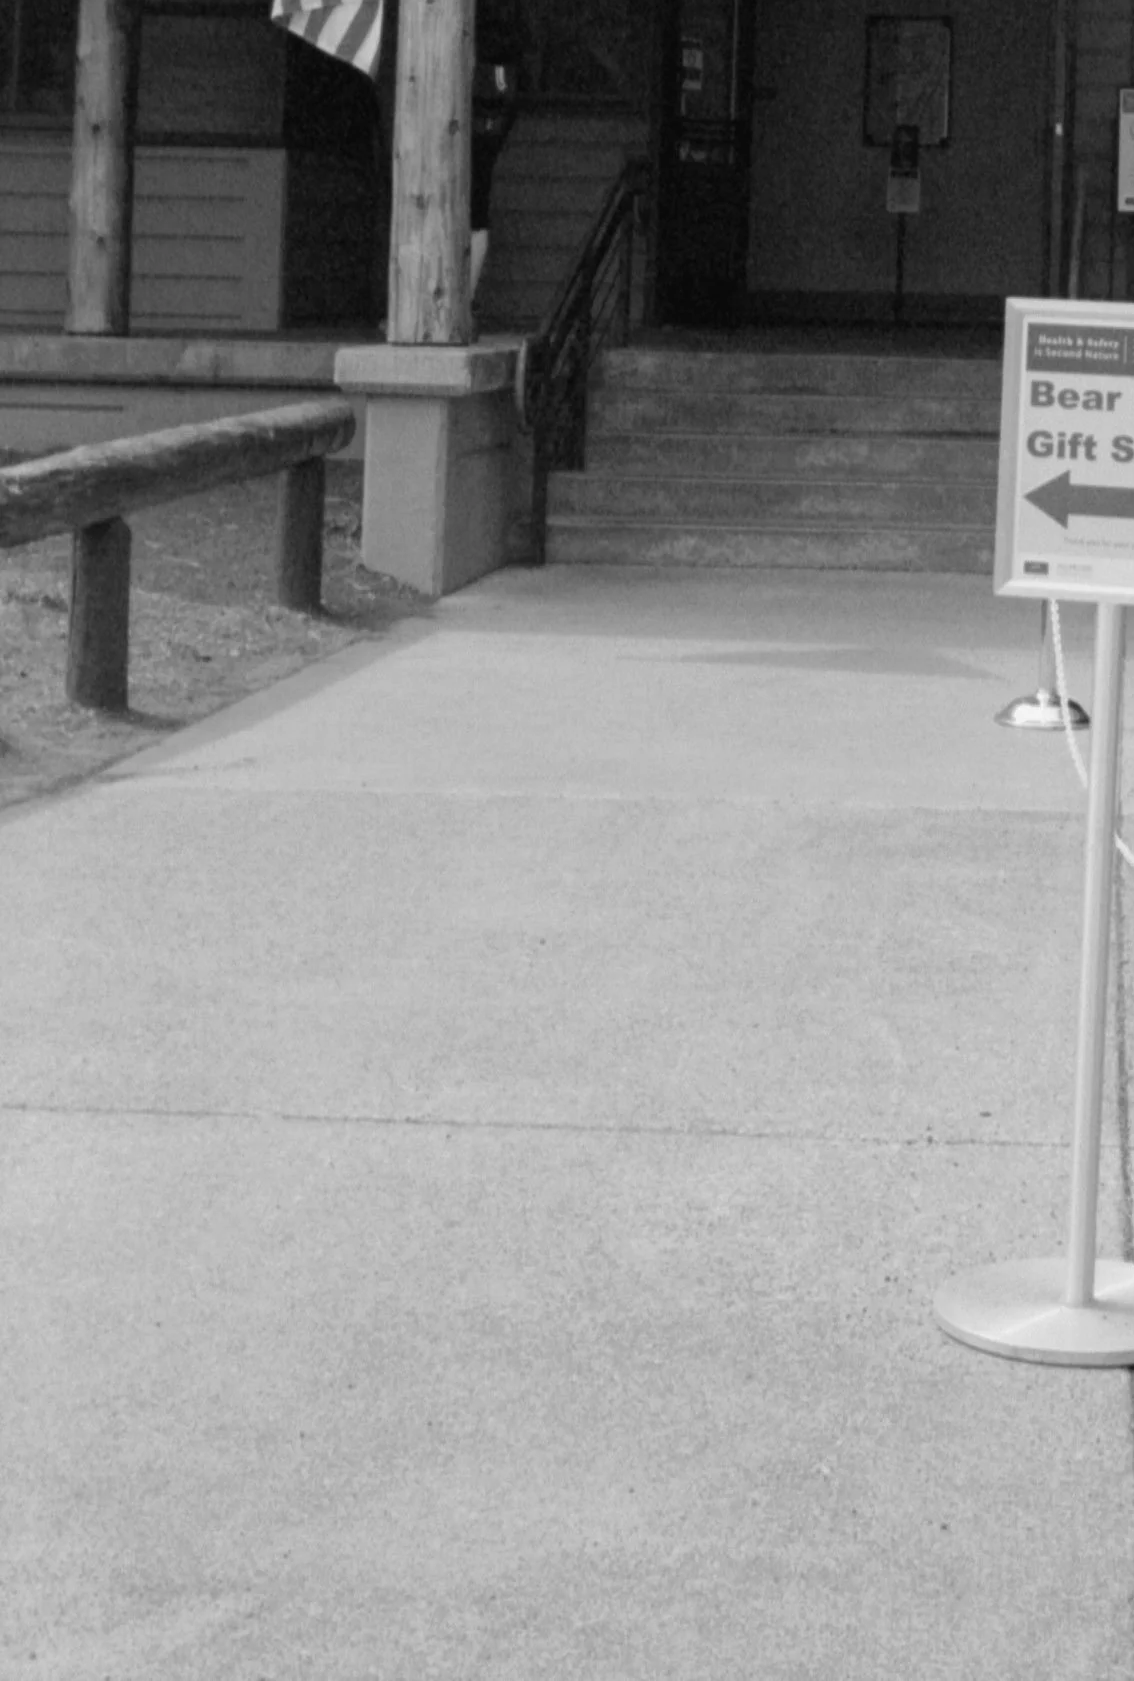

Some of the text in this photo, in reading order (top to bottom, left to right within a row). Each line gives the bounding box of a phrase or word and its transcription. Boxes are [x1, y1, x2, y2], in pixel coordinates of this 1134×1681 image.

[1038, 333, 1073, 346] Health
[1087, 337, 1120, 349] Safety
[1045, 347, 1082, 359] Second
[1085, 349, 1120, 361] Nature
[1030, 380, 1122, 412] Bear
[1026, 430, 1097, 461] Gift
